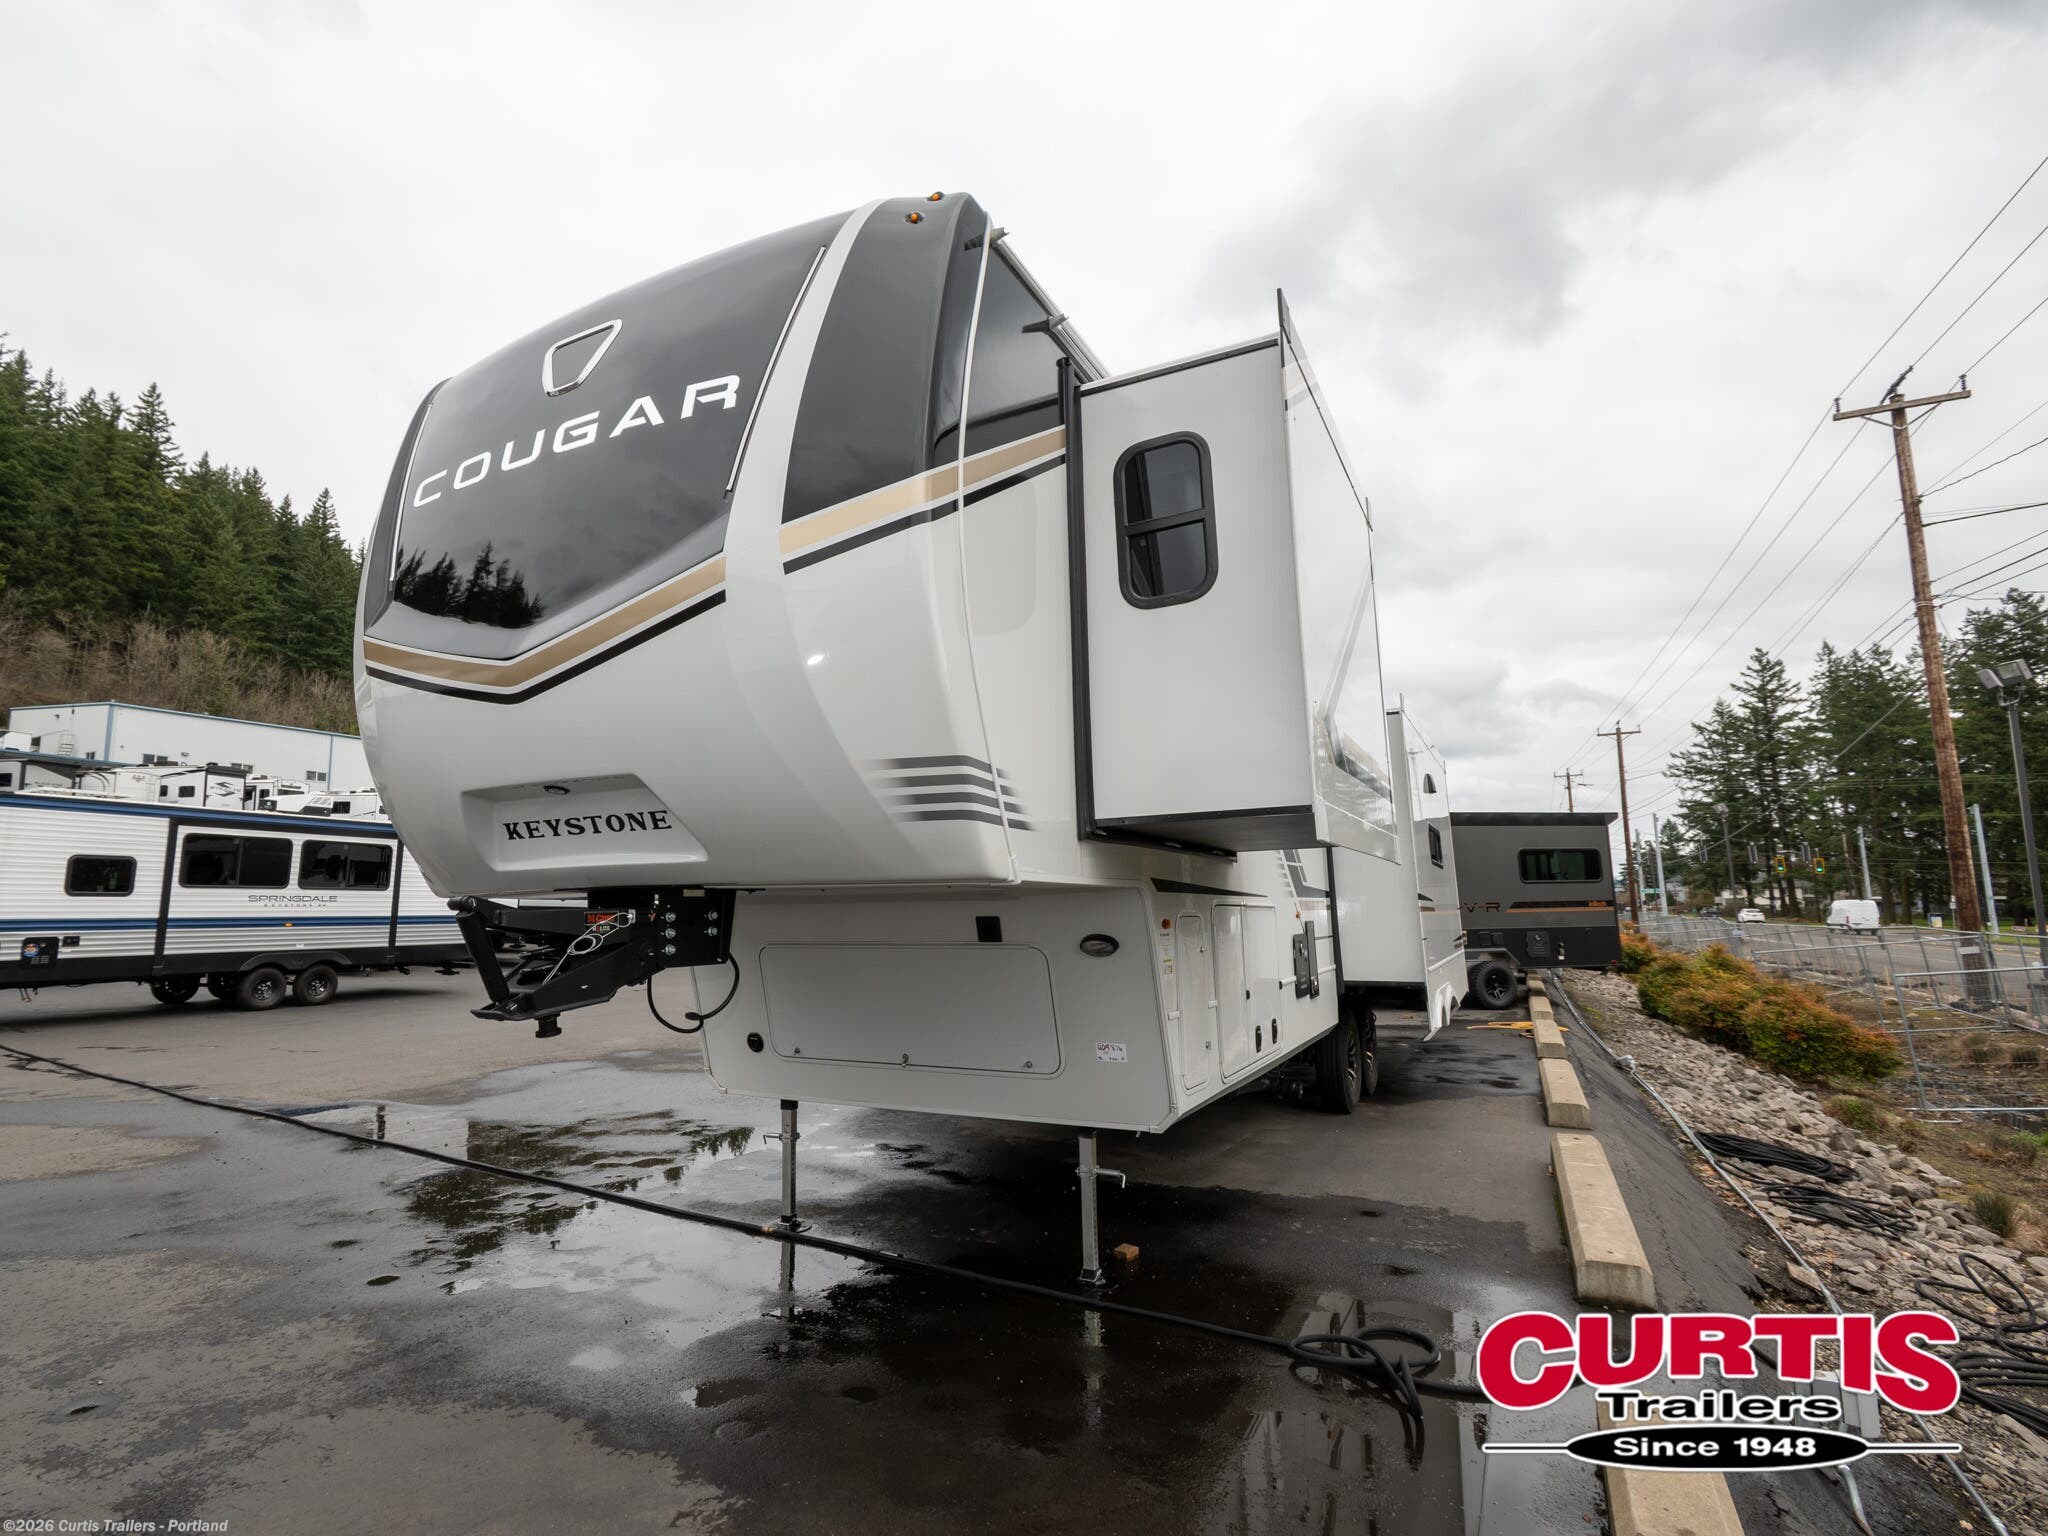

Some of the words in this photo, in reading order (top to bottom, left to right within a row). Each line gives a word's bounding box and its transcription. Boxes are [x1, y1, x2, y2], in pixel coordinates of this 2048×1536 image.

[413, 375, 740, 507] COUGAR
[503, 810, 672, 840] KEYSTONE
[248, 895, 338, 903] SPRINGDALE
